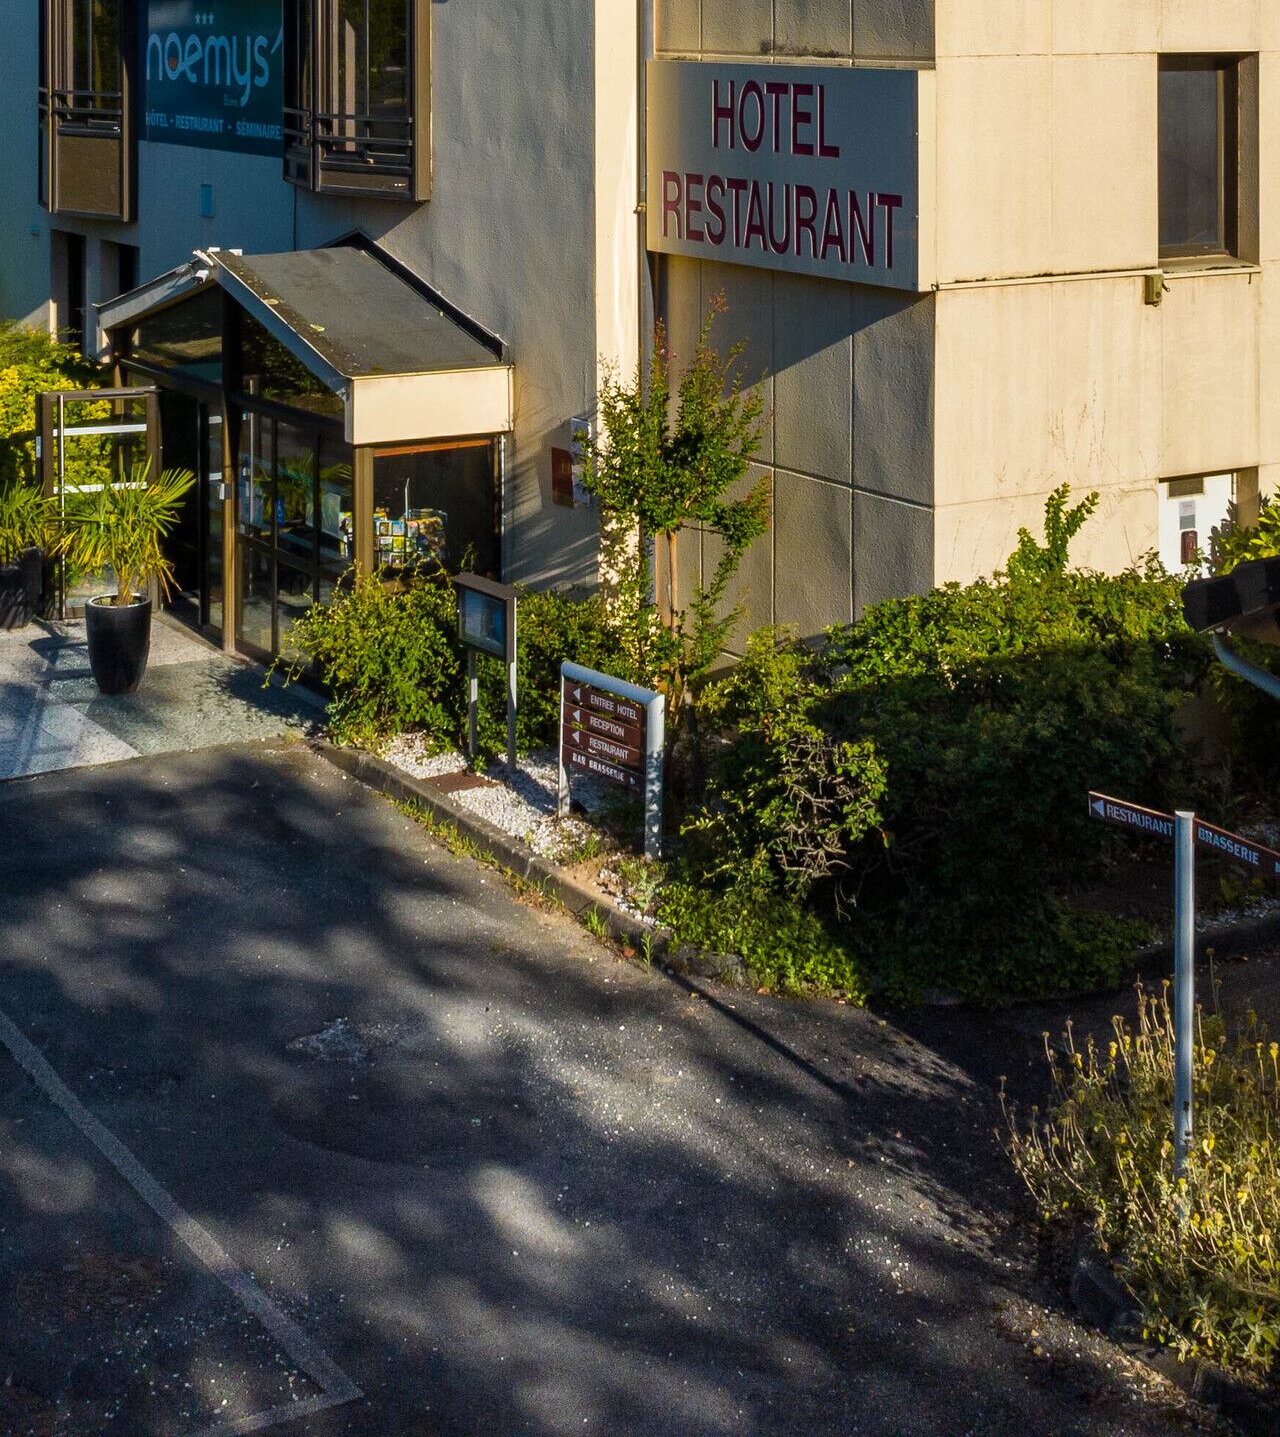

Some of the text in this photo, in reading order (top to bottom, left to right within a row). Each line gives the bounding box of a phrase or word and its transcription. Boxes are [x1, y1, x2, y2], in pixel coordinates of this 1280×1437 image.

[175, 113, 224, 134] RESTAURANT
[711, 79, 840, 158] HOTEL
[661, 170, 903, 270] RESTAURANT
[589, 716, 625, 737] RECEPTION
[617, 704, 637, 720] HOTEL
[589, 737, 628, 760] RESTAURANT
[572, 752, 625, 782] BAR BRASSERIE
[1106, 802, 1174, 837] RESTAURANT
[1197, 826, 1260, 866] BRASSERIE
